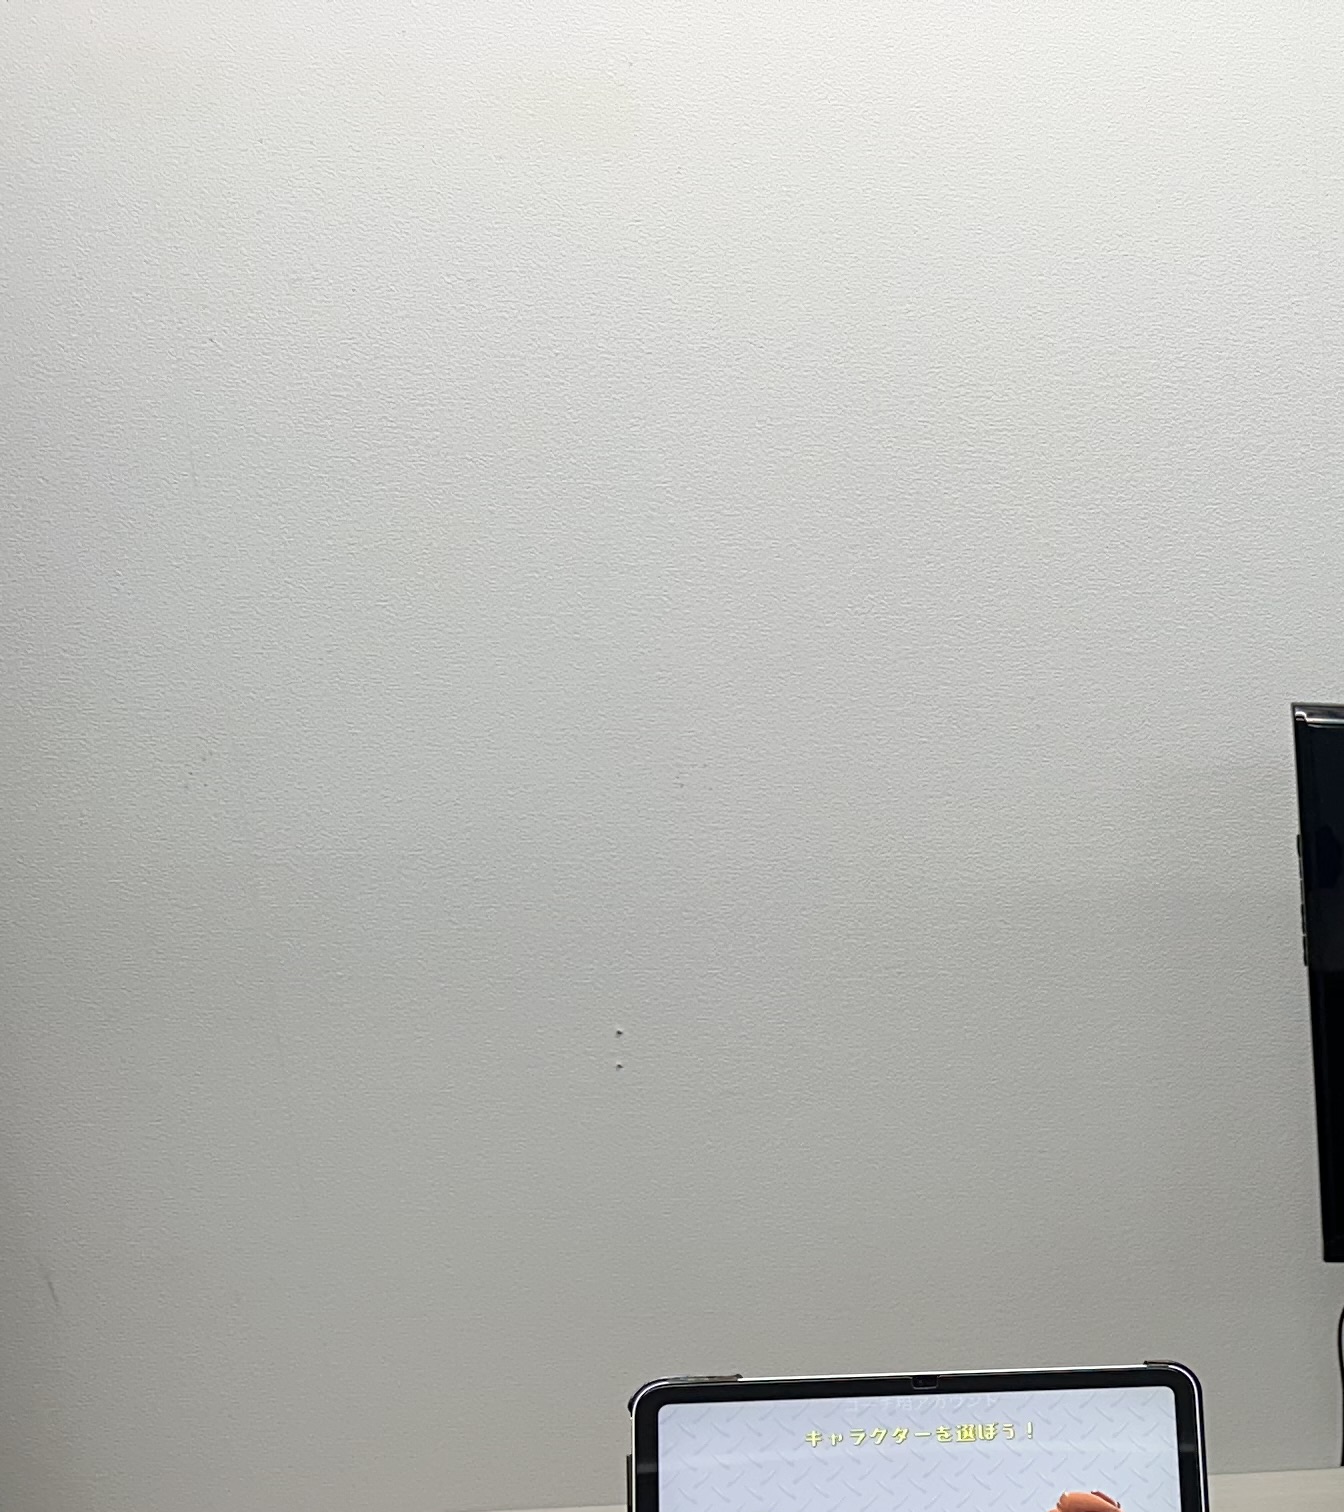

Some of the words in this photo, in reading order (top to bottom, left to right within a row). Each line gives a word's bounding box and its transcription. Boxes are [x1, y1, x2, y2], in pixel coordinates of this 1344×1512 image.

[804, 1421, 1035, 1448] キャラクターを選ぼう！
